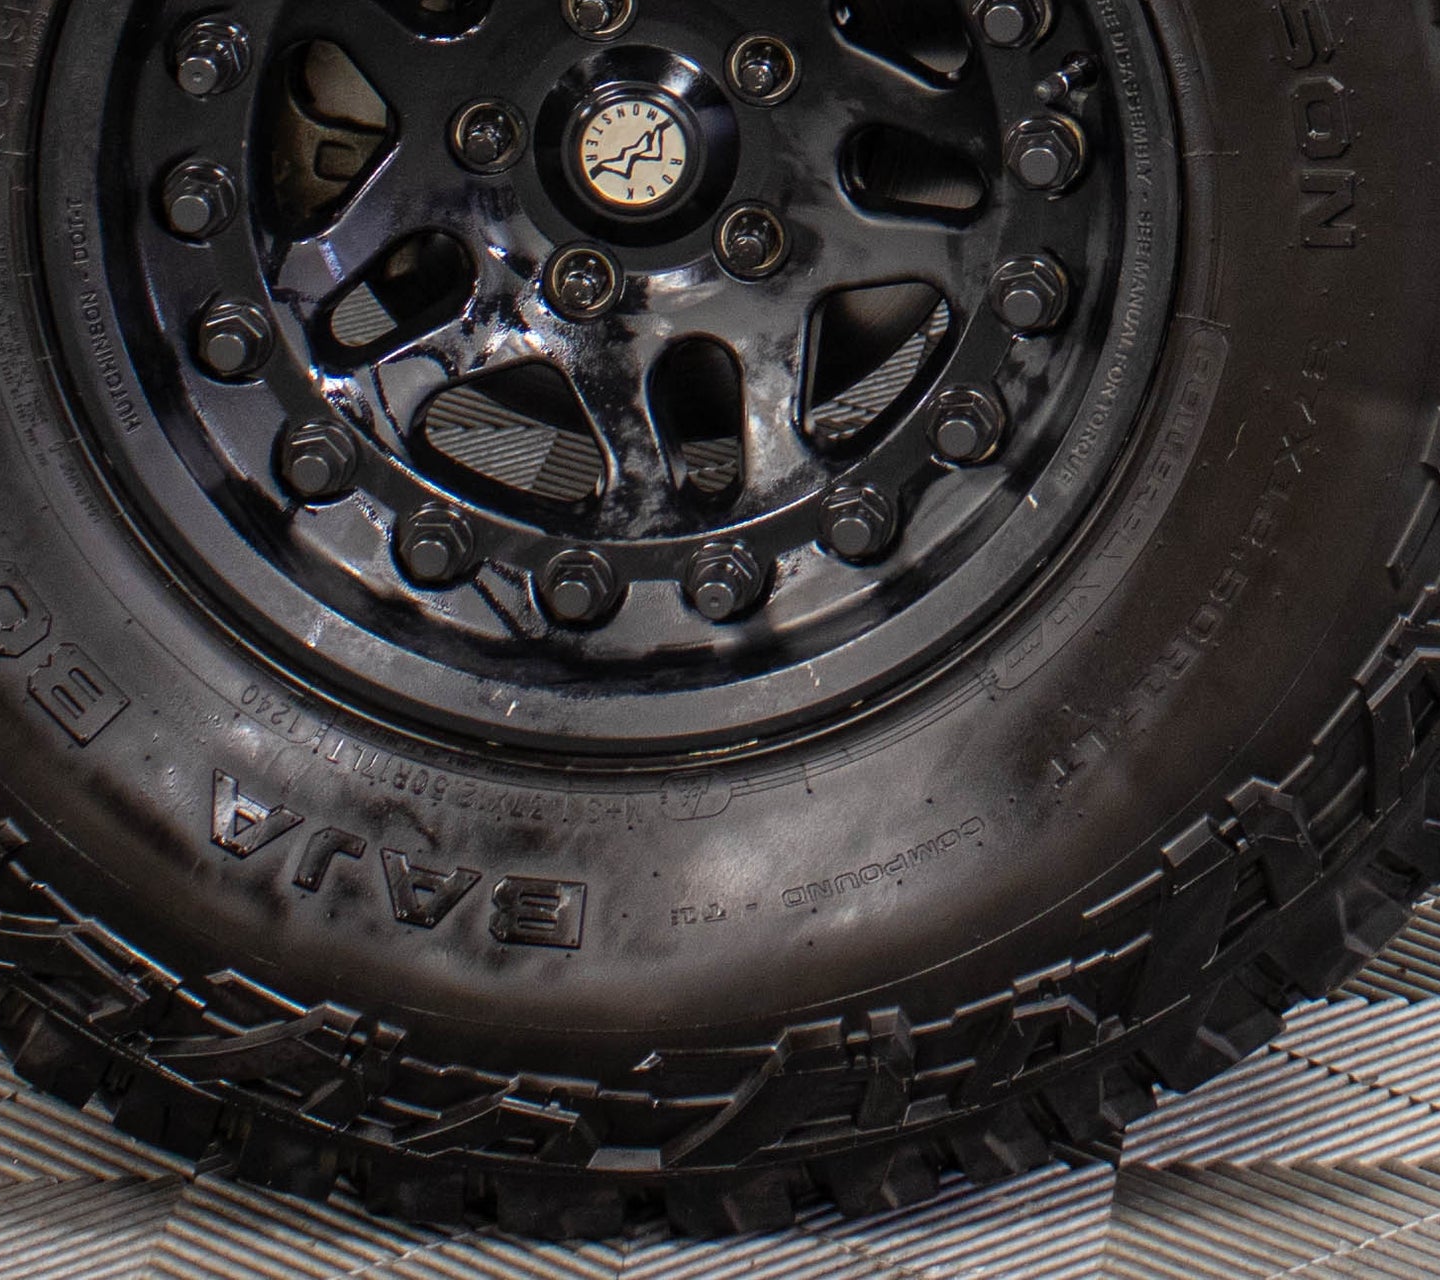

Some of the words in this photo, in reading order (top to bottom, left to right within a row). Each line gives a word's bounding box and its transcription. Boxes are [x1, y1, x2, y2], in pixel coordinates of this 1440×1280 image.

[585, 103, 659, 162] MONSTER
[626, 157, 683, 200] ROCK
[1114, 260, 1151, 351] MANUAL
[78, 288, 143, 435] HUTCHINSON
[211, 769, 587, 950] BAJA
[782, 816, 985, 908] COMPOUND
